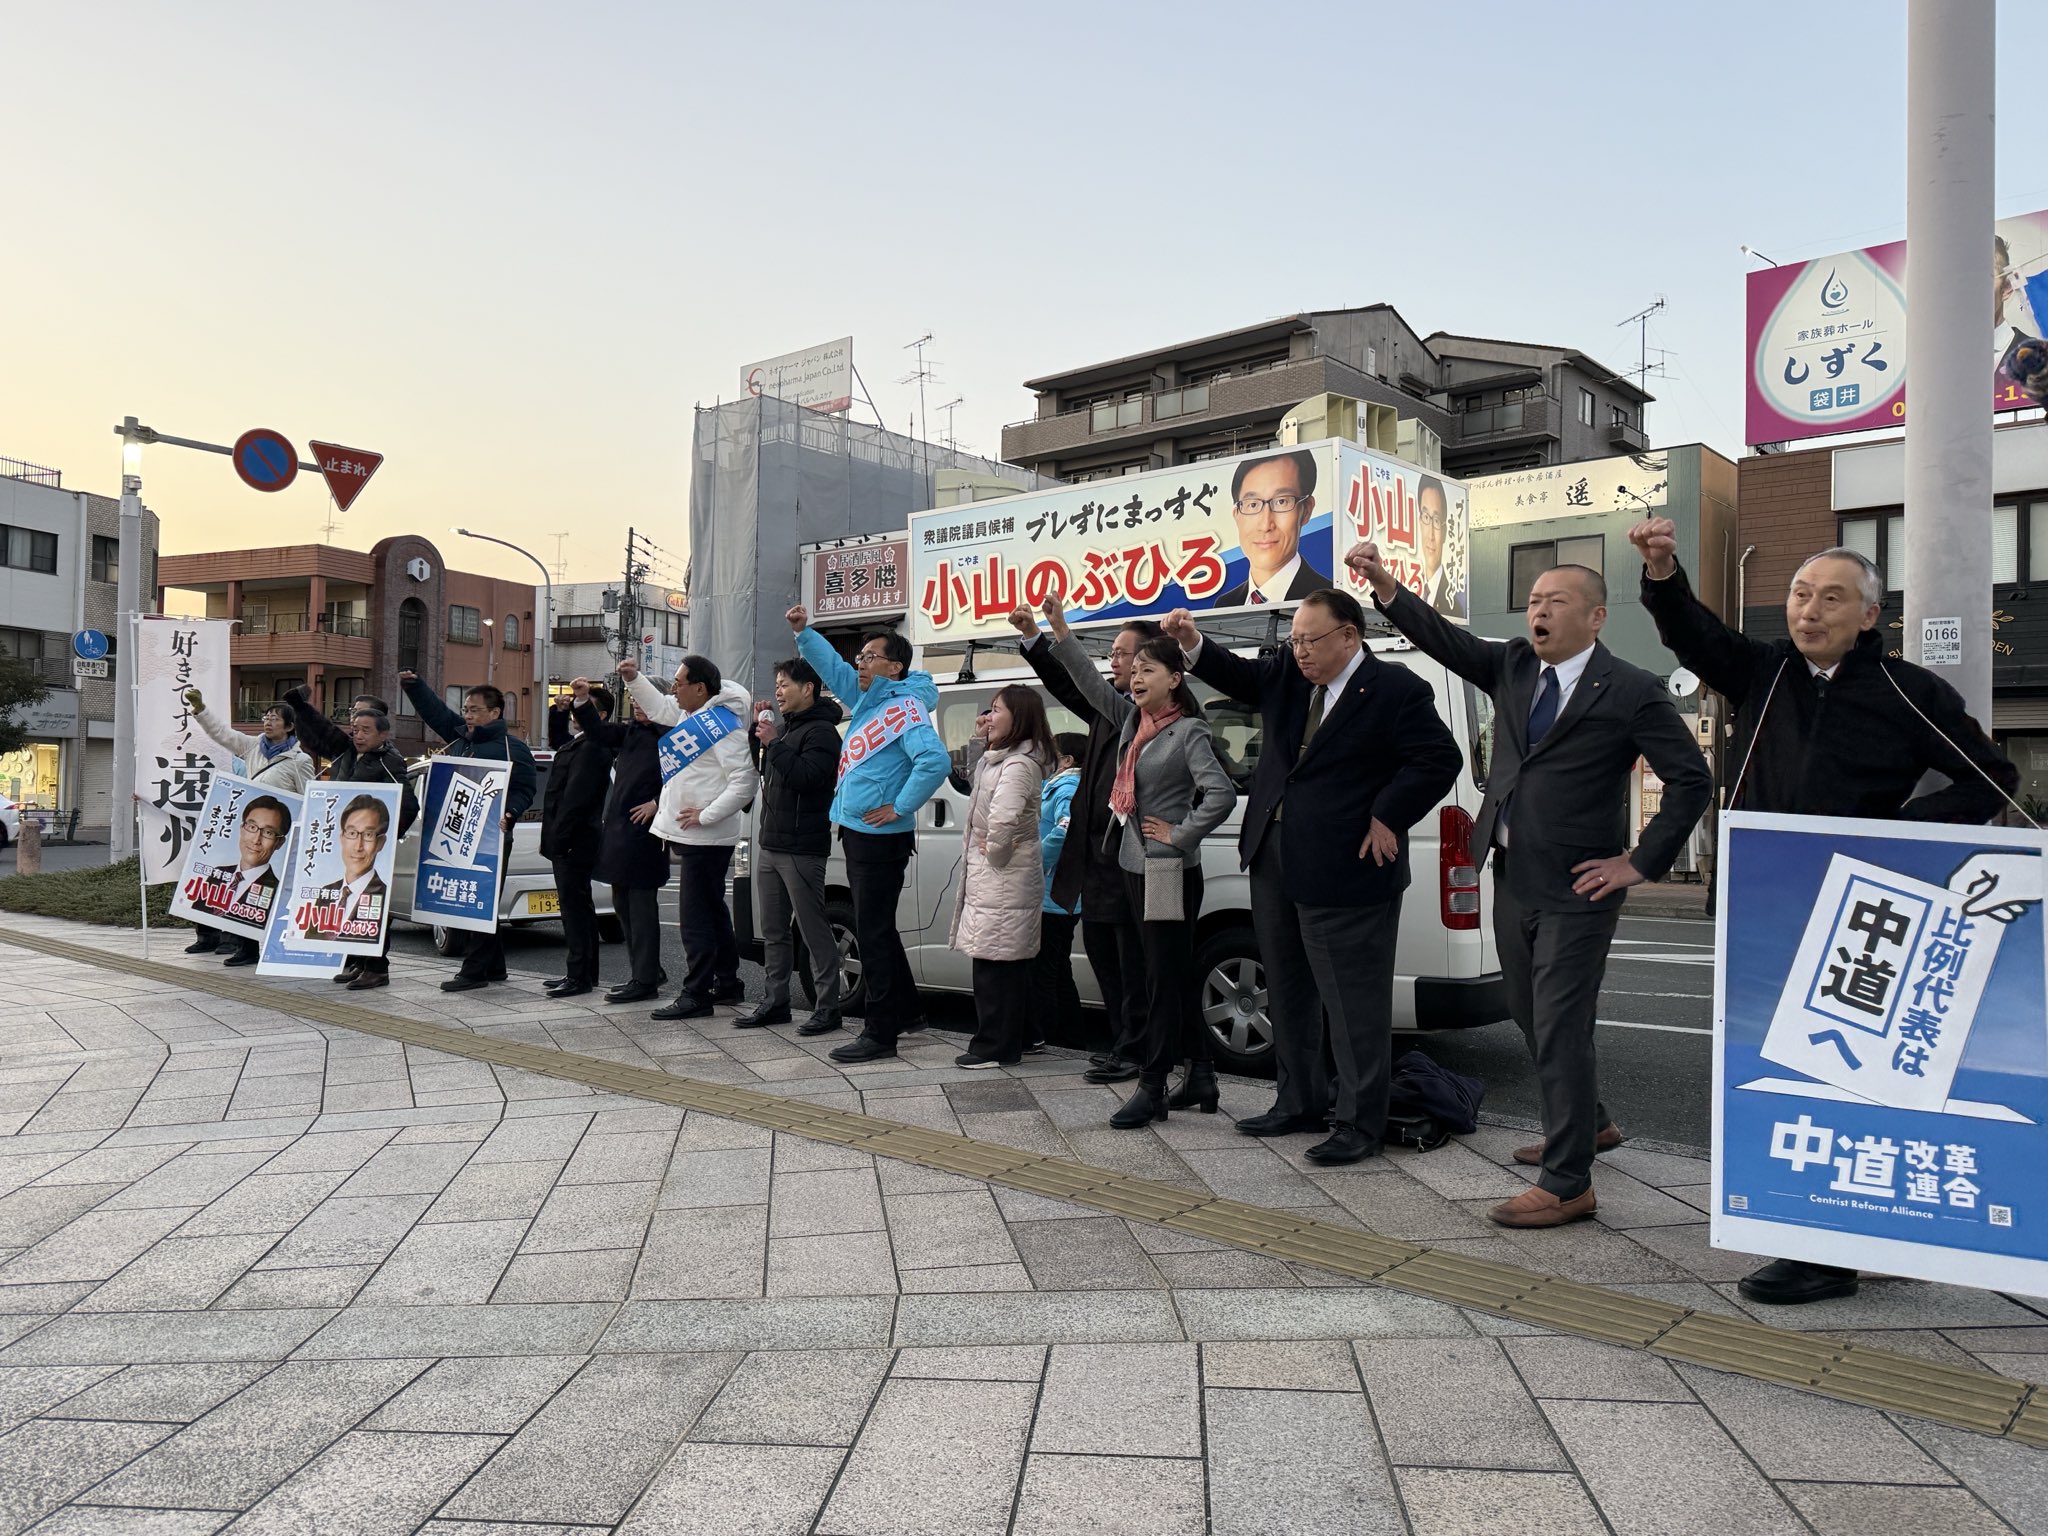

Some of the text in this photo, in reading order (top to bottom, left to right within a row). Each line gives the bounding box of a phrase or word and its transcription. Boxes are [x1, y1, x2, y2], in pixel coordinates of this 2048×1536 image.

[1797, 319, 1874, 341] 家族葬ホール
[823, 348, 844, 360] 株式会社
[1784, 342, 1888, 385] しずく
[1812, 387, 1857, 407] 袋井
[324, 457, 367, 476] 止まれ
[923, 482, 1219, 545] 衆議院議員候補 ブレずにまっすぐ
[1348, 464, 1415, 549] 小山
[840, 549, 881, 568] 居酒屋風
[957, 556, 979, 567] こやま
[921, 535, 1222, 625] 小山のぶひろ
[819, 590, 903, 611] 2階20席あります
[1925, 627, 1958, 641] 0166
[699, 712, 723, 740] 比例区
[200, 806, 222, 855] まっすぐ
[219, 789, 245, 839] ブレずに
[320, 795, 340, 854] ブレずに
[460, 791, 485, 858] 比例代表は
[304, 820, 320, 877] まっすぐ
[184, 876, 266, 923] 小山のぶひろ
[427, 872, 459, 902] 中道
[295, 901, 379, 936] 小山のぶひろ
[1891, 905, 1976, 1078] 比例代表は
[1769, 1114, 1900, 1199] 中道
[1904, 1139, 1979, 1175] 改革
[1809, 1194, 1934, 1219] Centrist Reform Alliance
[1904, 1170, 1981, 1209] 連合
